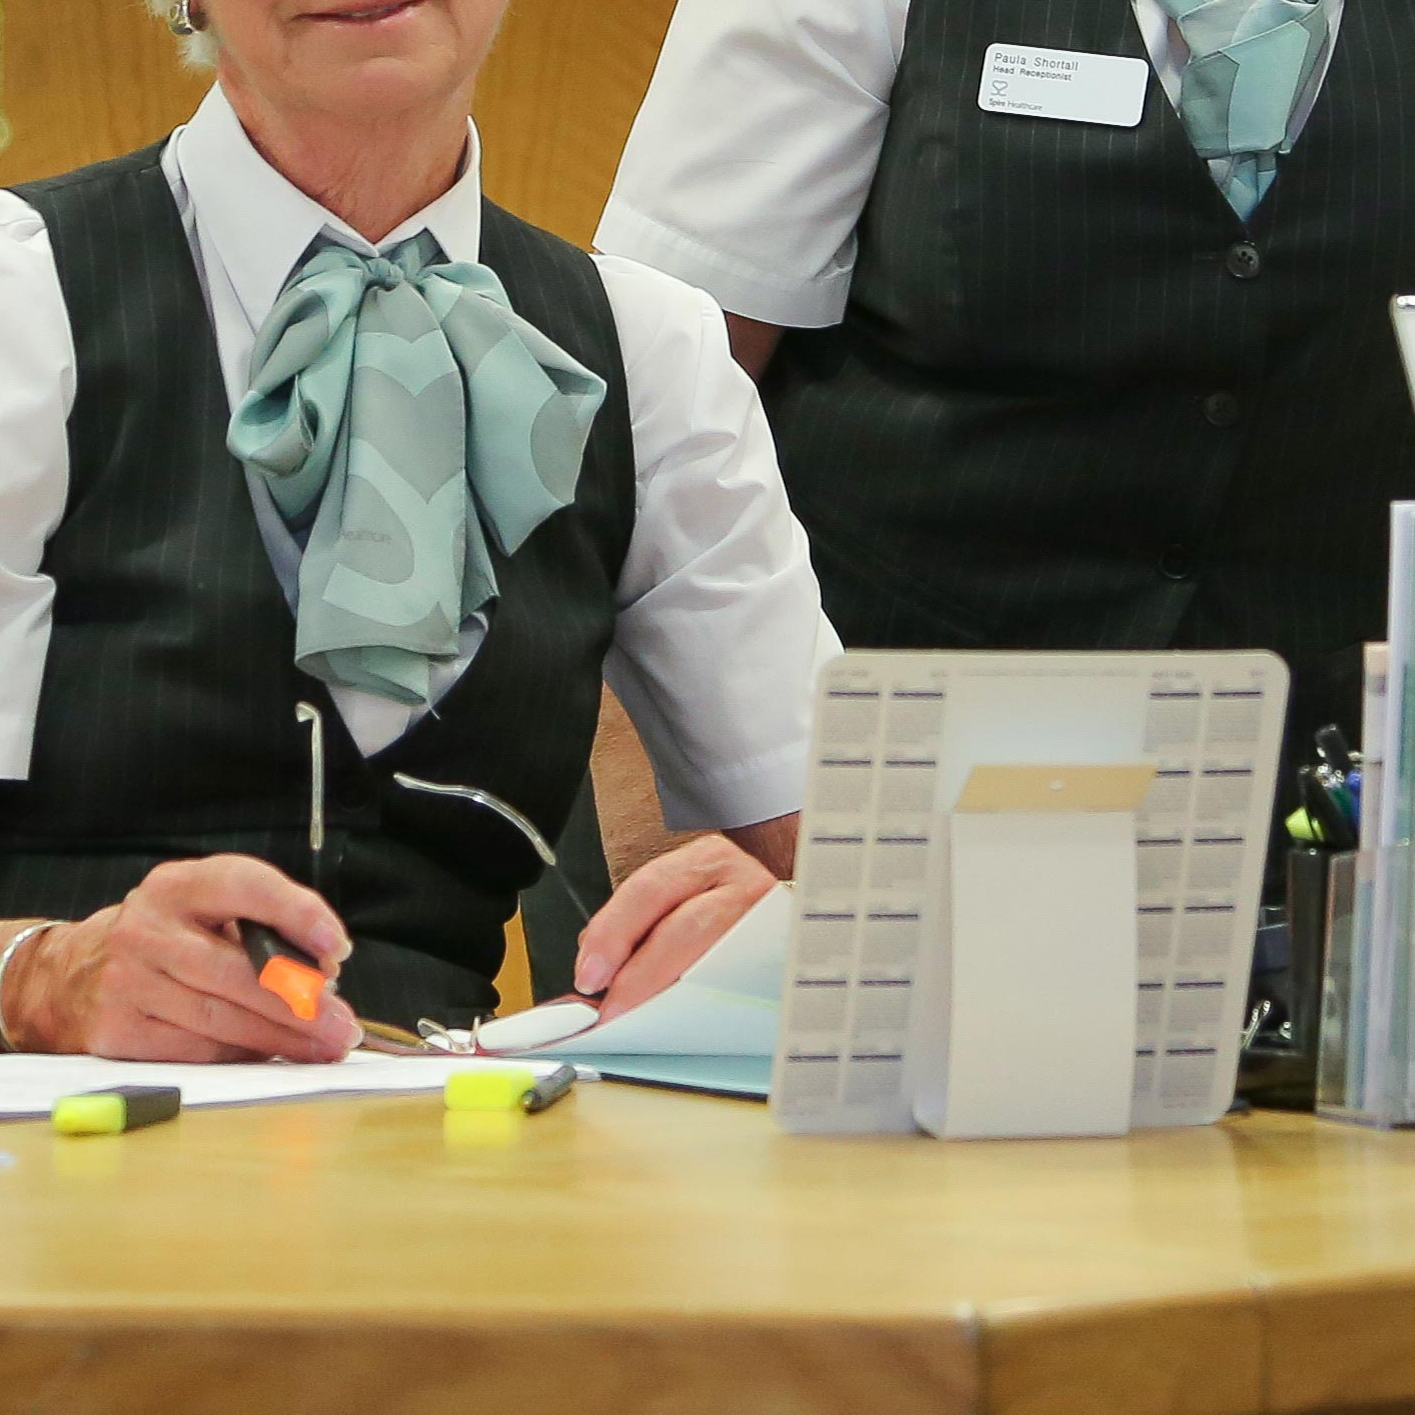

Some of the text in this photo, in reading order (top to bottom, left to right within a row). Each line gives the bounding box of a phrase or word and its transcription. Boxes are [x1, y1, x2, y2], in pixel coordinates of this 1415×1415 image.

[994, 52, 1079, 71] Paula Shortall
[993, 65, 1072, 82] Head Receptionist
[988, 98, 1043, 112] Spire Healthcare
